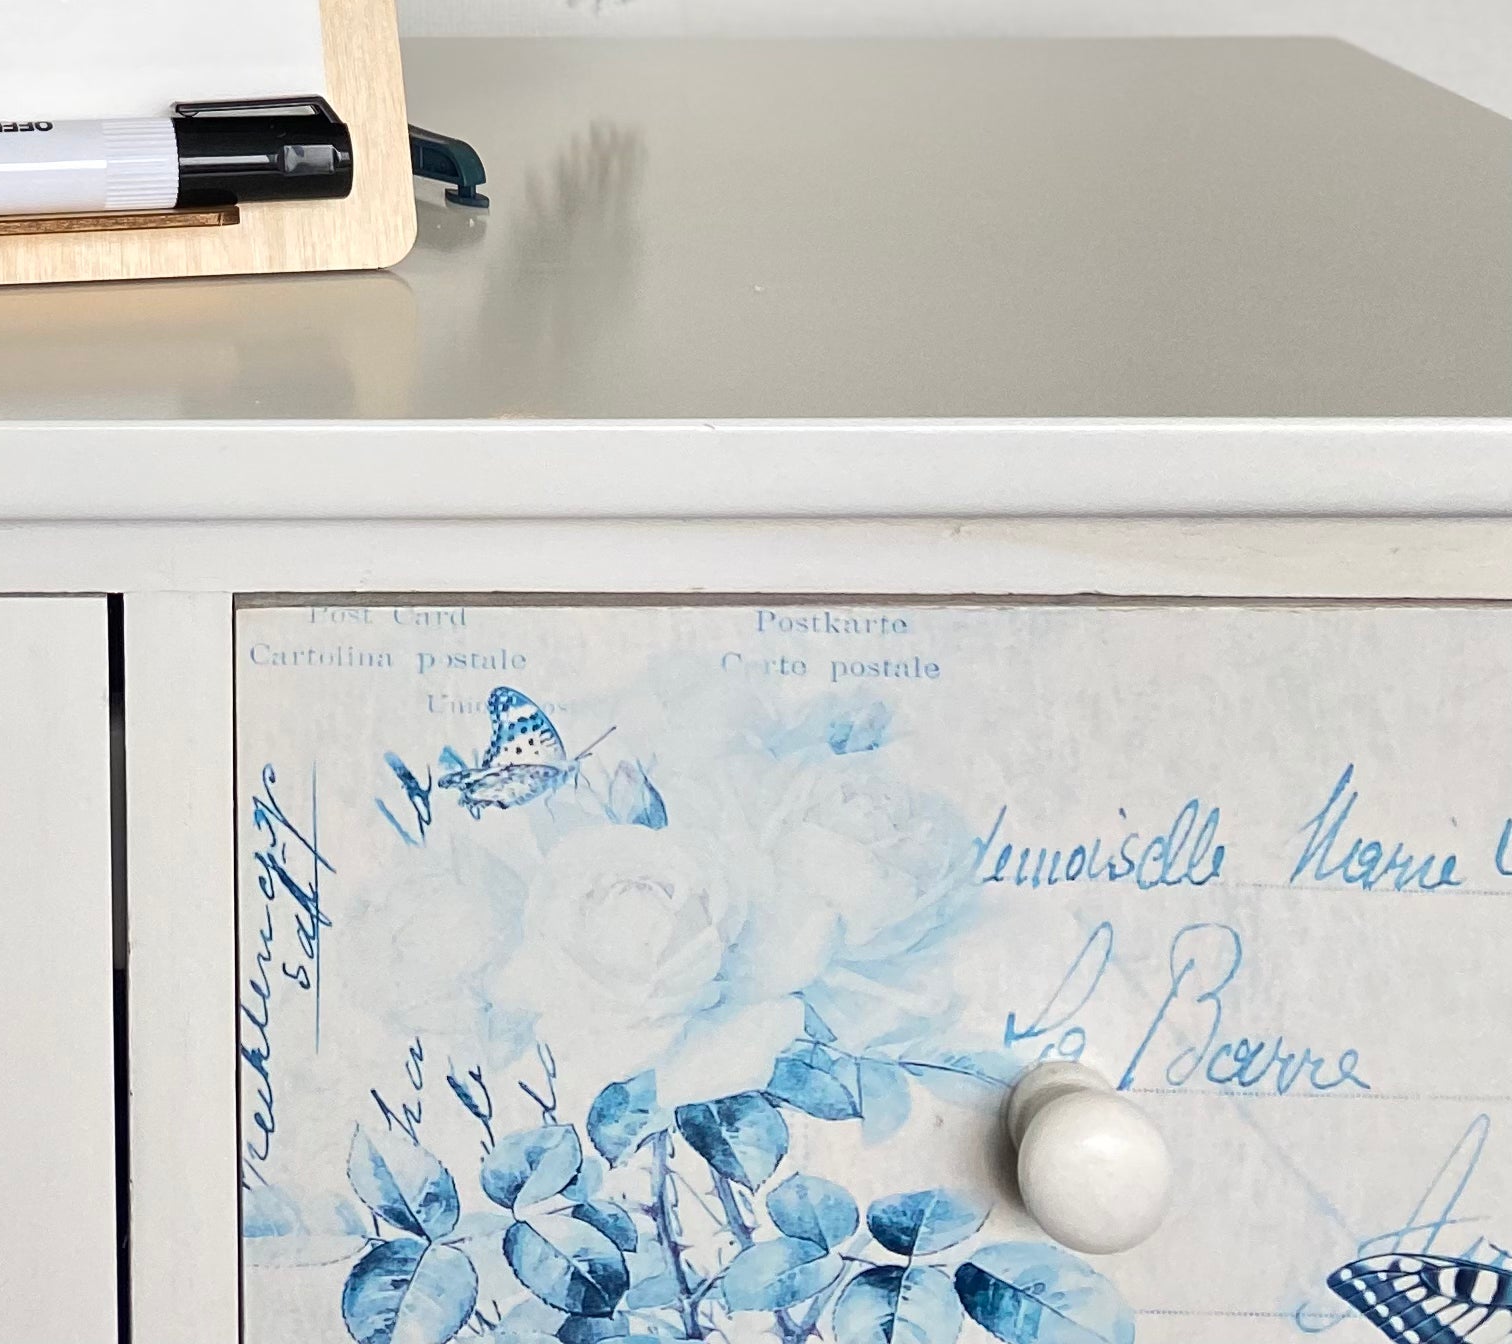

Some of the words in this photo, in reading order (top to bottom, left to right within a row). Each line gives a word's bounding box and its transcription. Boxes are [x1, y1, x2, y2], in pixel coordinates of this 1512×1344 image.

[308, 608, 373, 624] Post
[394, 608, 467, 626] Card
[757, 610, 909, 634] Postkarte
[250, 643, 393, 667] Cartolina
[417, 649, 527, 674] postale
[721, 651, 807, 676] Crte
[831, 656, 941, 682] postale
